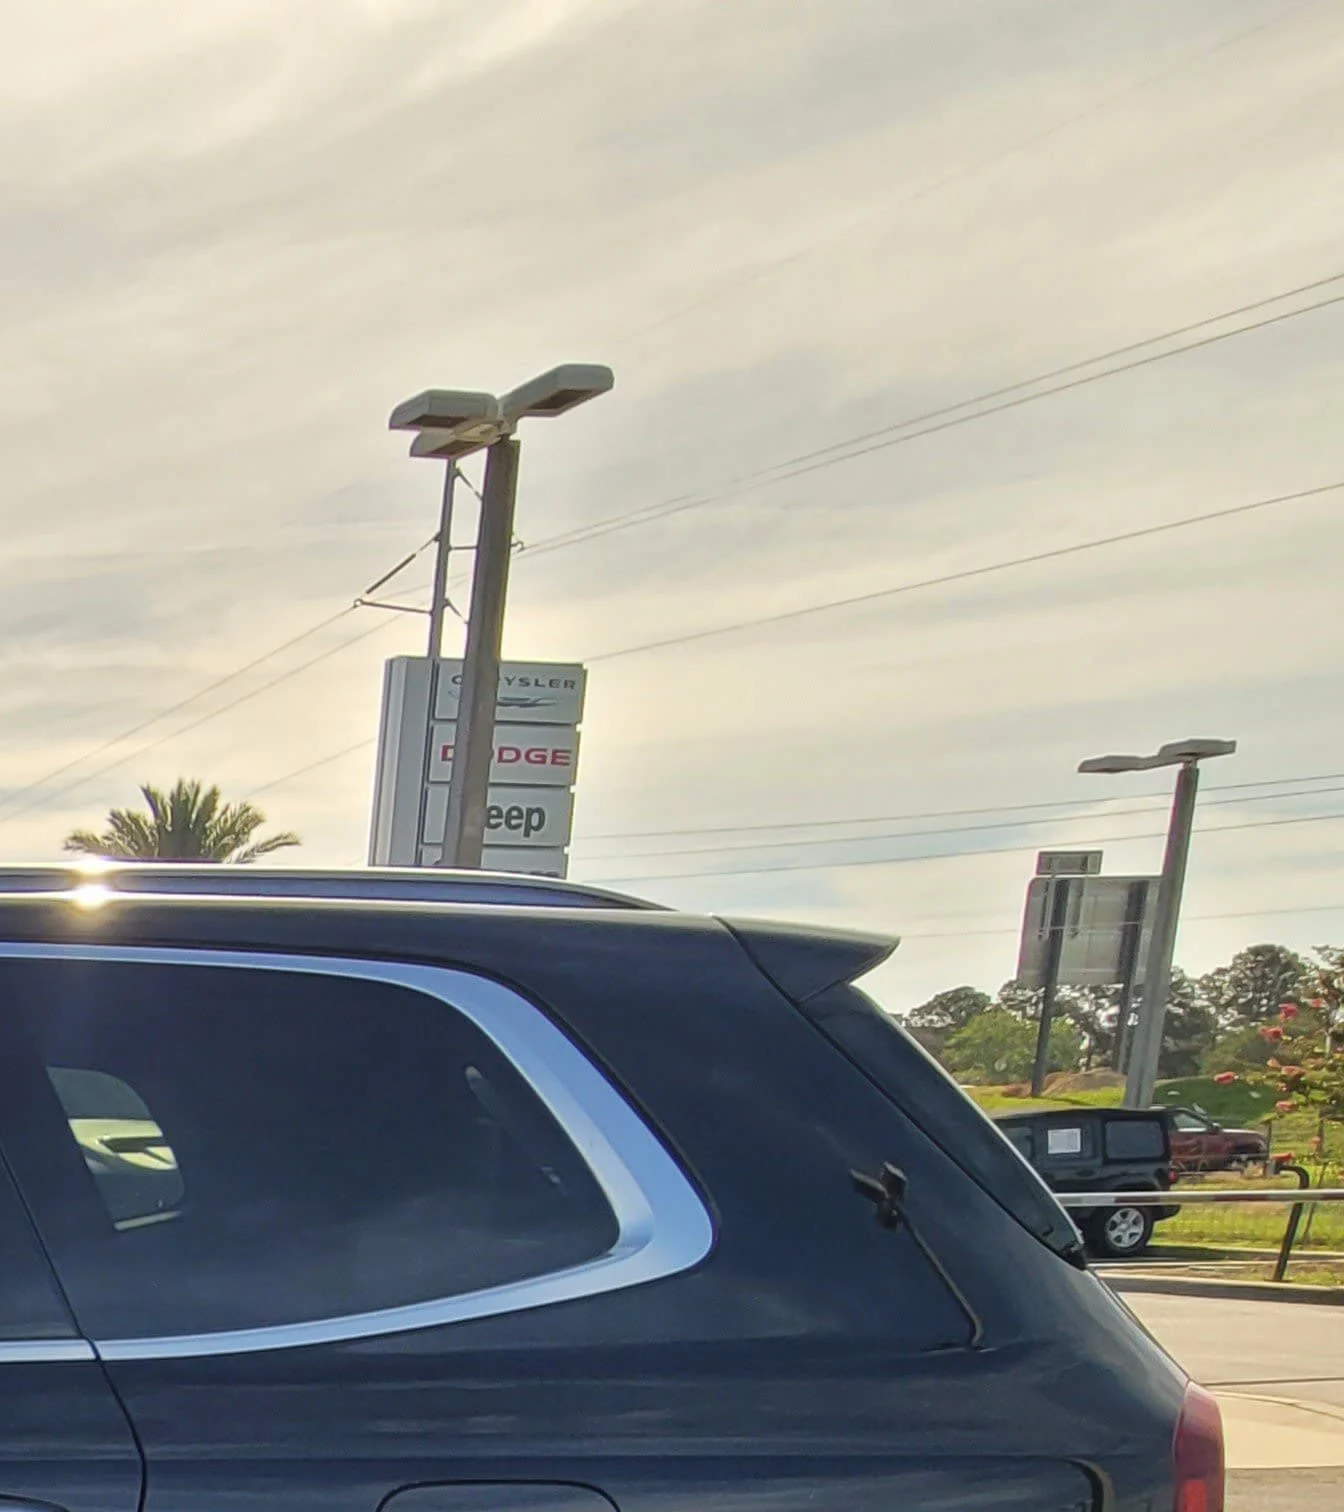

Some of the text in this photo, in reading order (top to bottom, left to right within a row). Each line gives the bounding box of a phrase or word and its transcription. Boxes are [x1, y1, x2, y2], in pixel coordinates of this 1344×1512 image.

[451, 675, 576, 690] CYSLER
[440, 744, 571, 766] DDGE
[486, 804, 546, 838] eep
